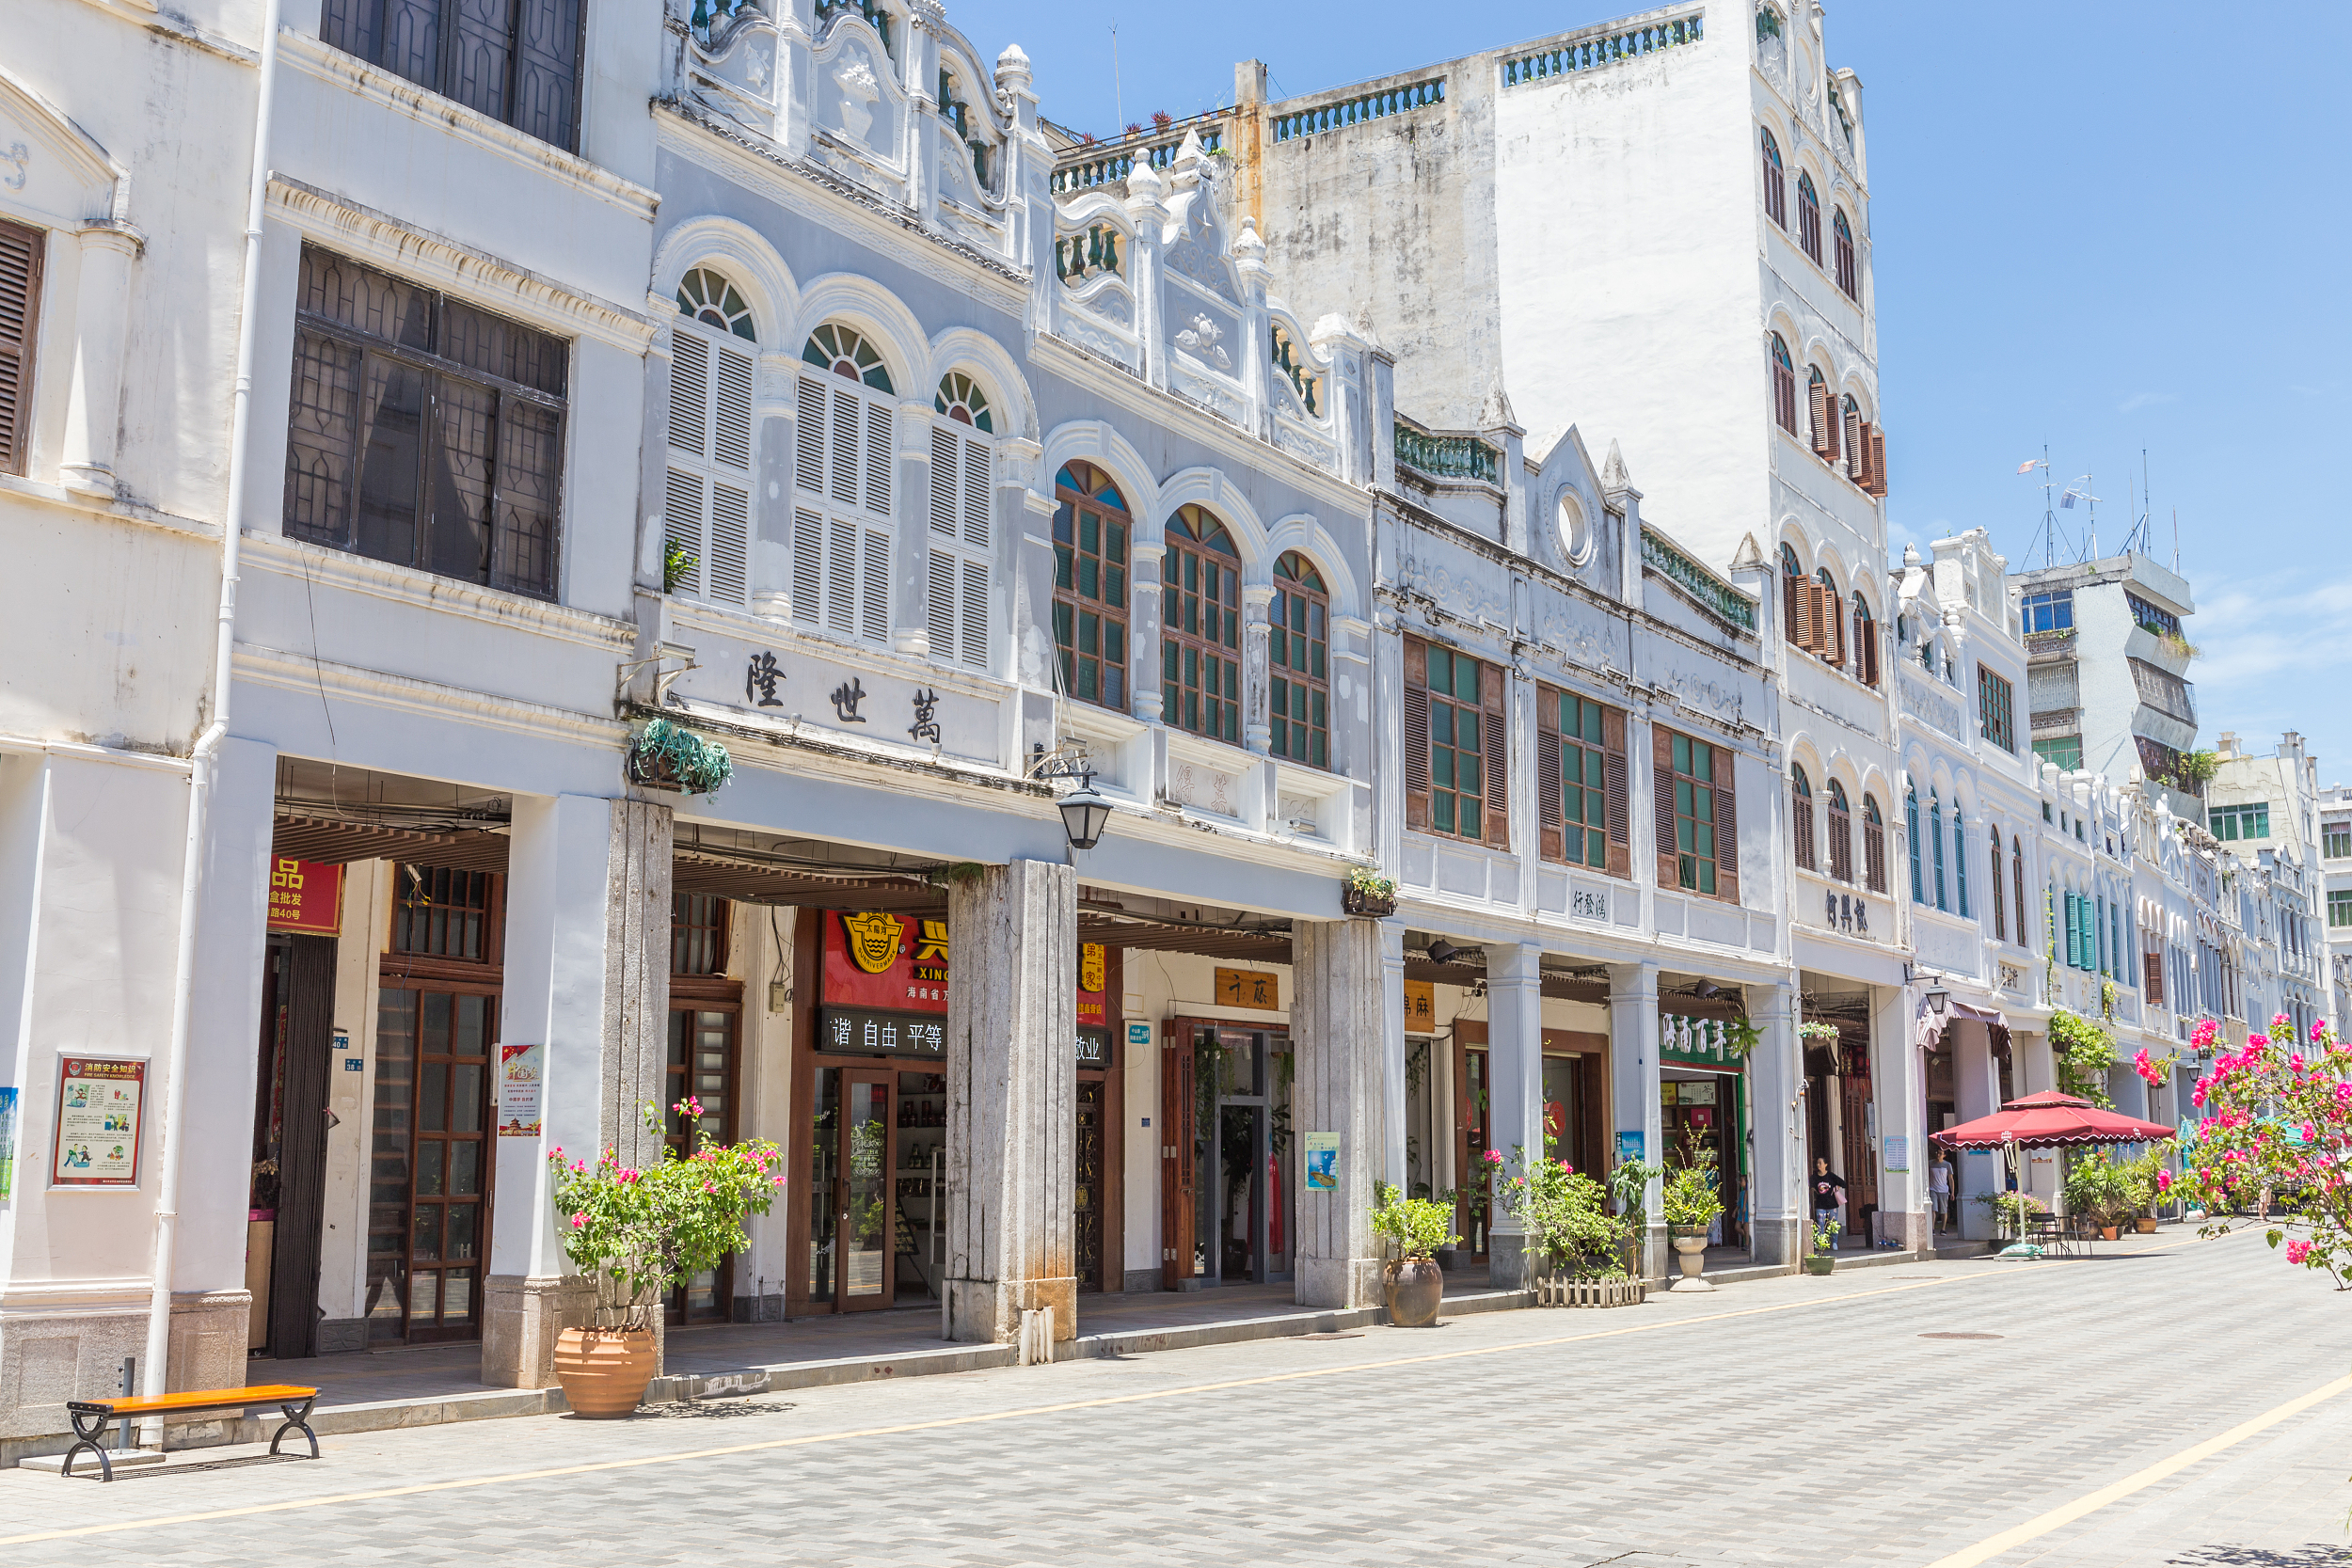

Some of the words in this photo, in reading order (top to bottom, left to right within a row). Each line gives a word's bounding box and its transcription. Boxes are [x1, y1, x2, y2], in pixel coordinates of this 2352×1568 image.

[272, 859, 304, 890] 品
[267, 908, 300, 920] 路40号
[864, 1019, 898, 1048] 自由
[907, 1023, 942, 1052] 平等
[85, 1063, 135, 1073] 消防安全知识
